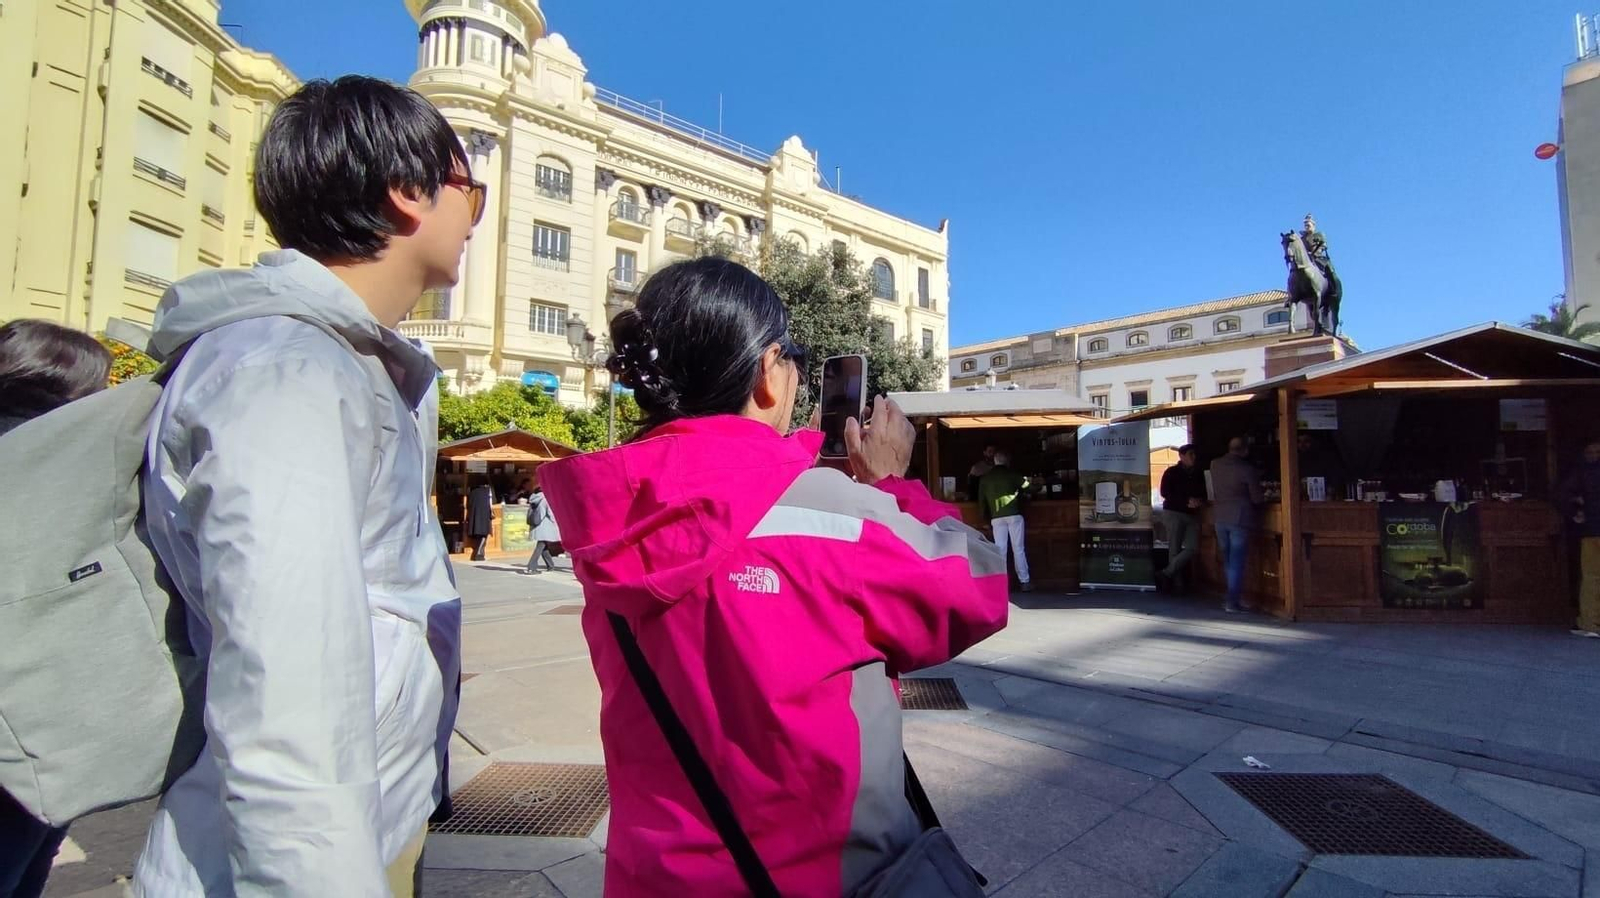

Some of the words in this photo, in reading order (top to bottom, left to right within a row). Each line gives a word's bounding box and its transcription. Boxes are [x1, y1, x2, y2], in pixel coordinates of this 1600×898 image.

[745, 566, 765, 575] THE
[728, 572, 764, 584] NORTH
[737, 582, 763, 593] FACE
